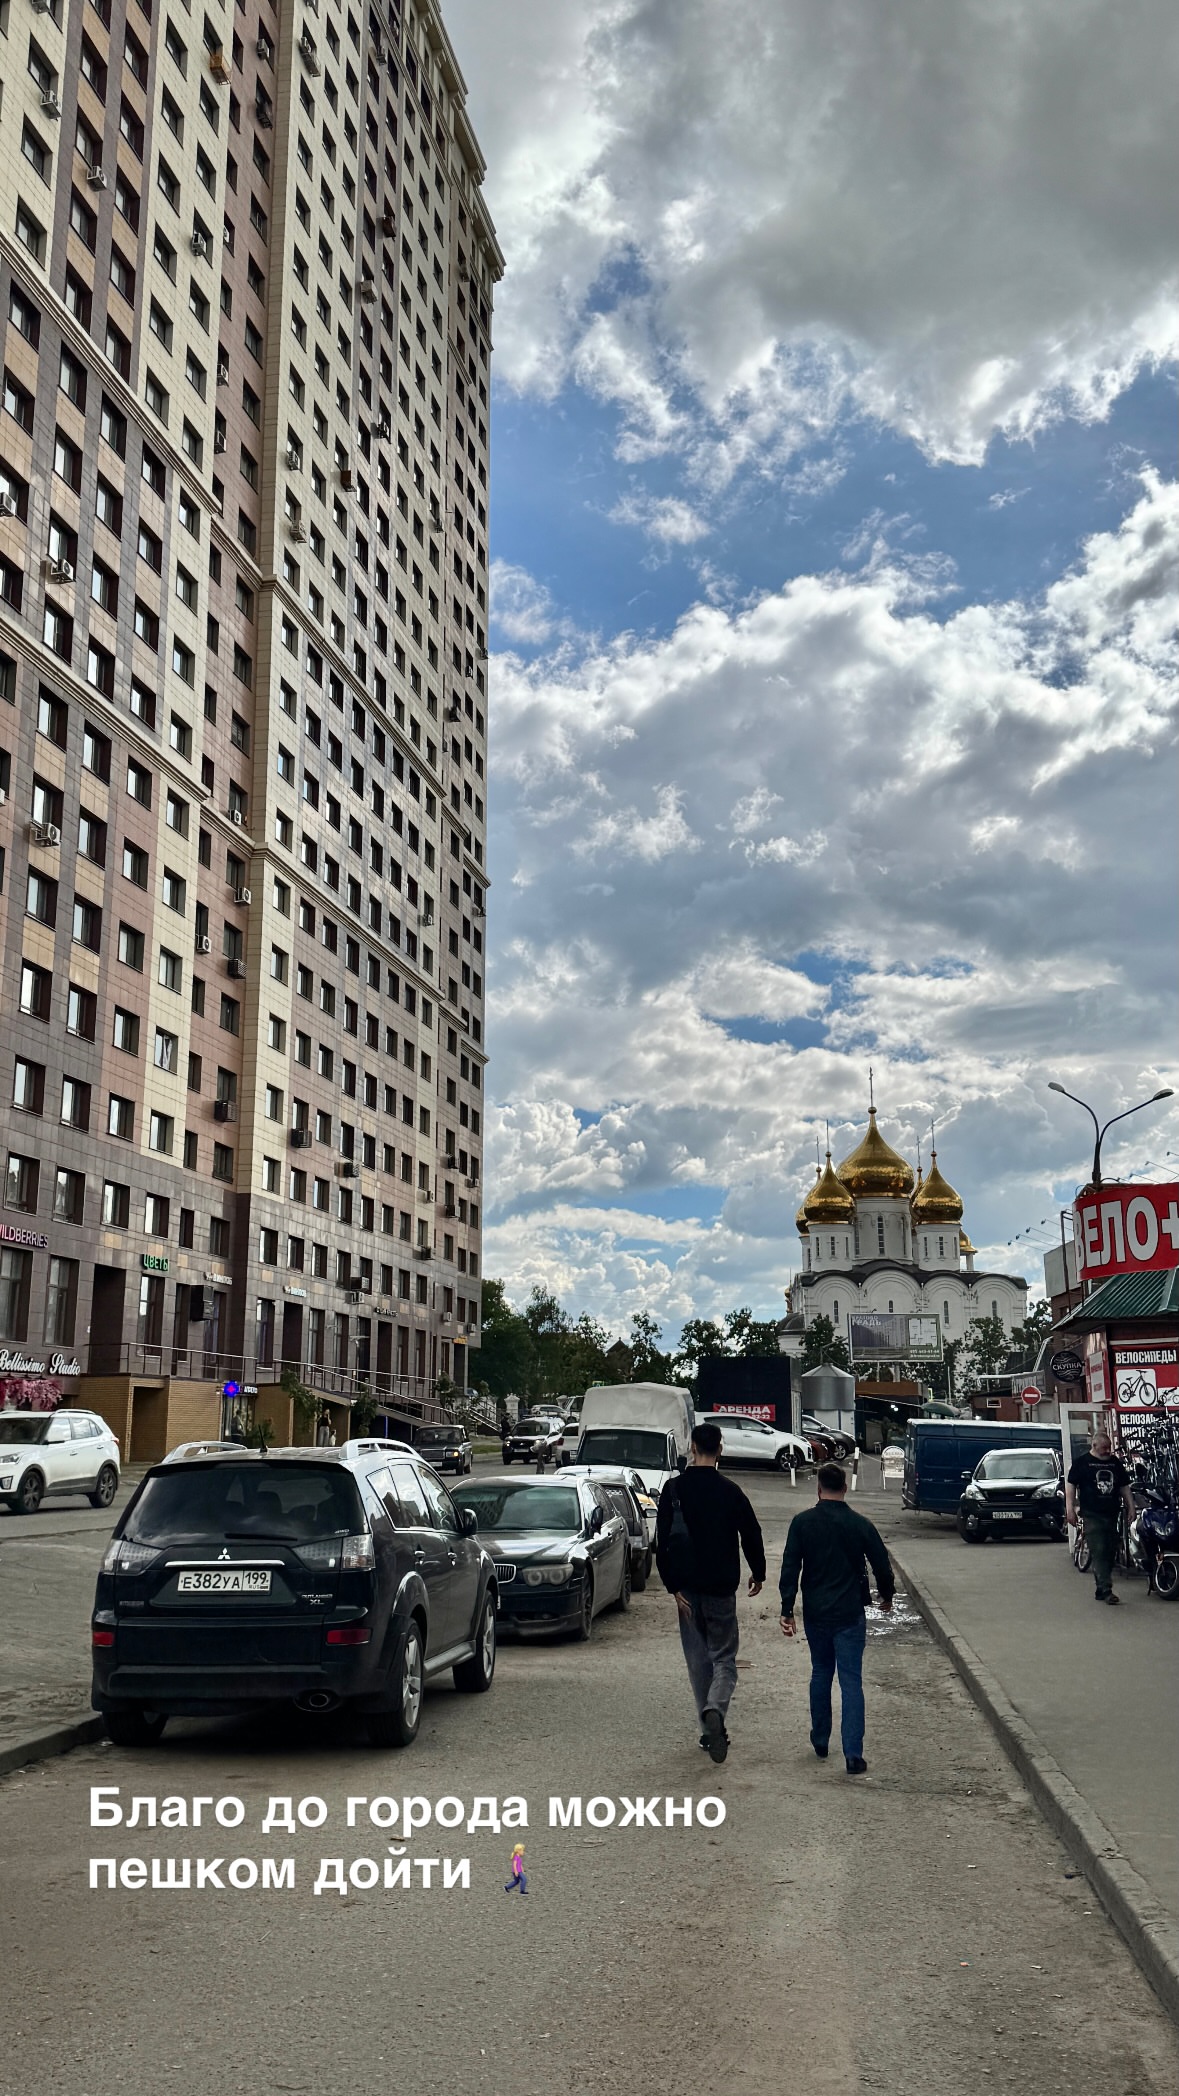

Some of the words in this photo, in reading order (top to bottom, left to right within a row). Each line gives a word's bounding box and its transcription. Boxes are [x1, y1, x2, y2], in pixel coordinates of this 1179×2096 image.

[143, 1254, 170, 1271] ЦВЕТЫ
[0, 1349, 46, 1373] Bellissimo
[50, 1353, 81, 1376] Studio
[1115, 1350, 1177, 1364] ВЕЛОСИПЕДЫ
[1052, 1362, 1082, 1371] СКУПКА
[718, 1405, 771, 1416] АРЕНДА
[245, 1572, 268, 1585] 199
